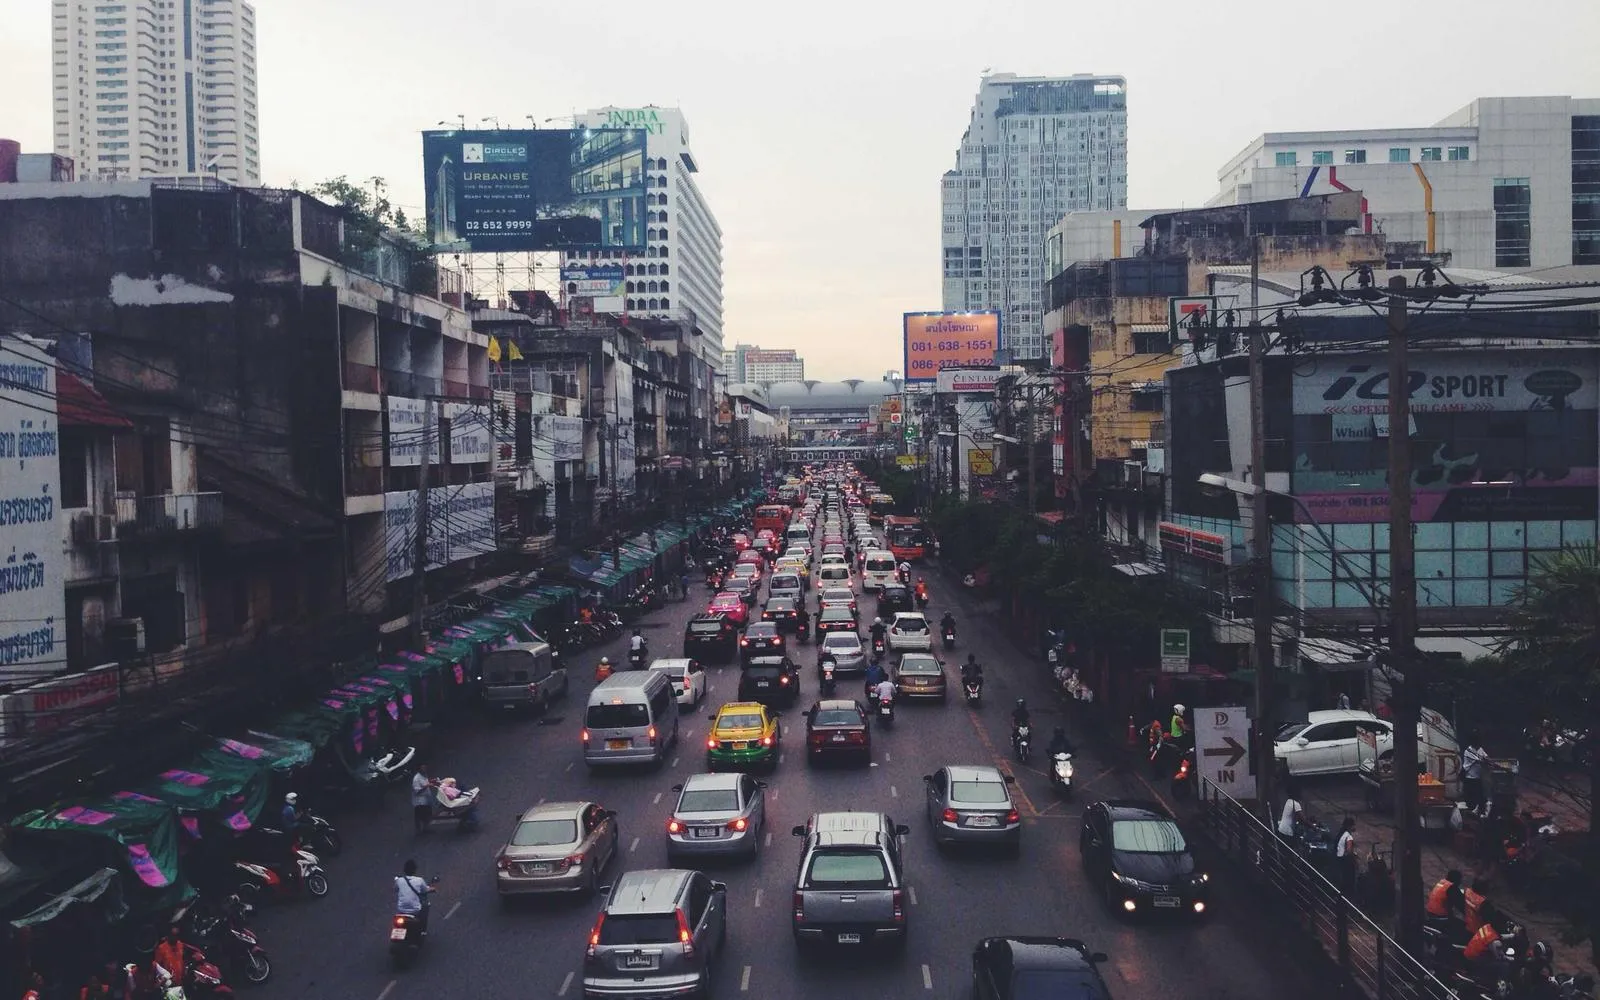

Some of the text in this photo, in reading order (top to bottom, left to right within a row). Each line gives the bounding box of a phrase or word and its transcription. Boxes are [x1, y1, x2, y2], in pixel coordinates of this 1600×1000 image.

[608, 111, 658, 122] INDRA
[463, 172, 529, 181] URBANISE
[466, 221, 532, 230] 02 652 9999
[911, 341, 992, 352] 081-638-1551
[1431, 374, 1508, 398] SPORT
[1217, 770, 1235, 784] IN
